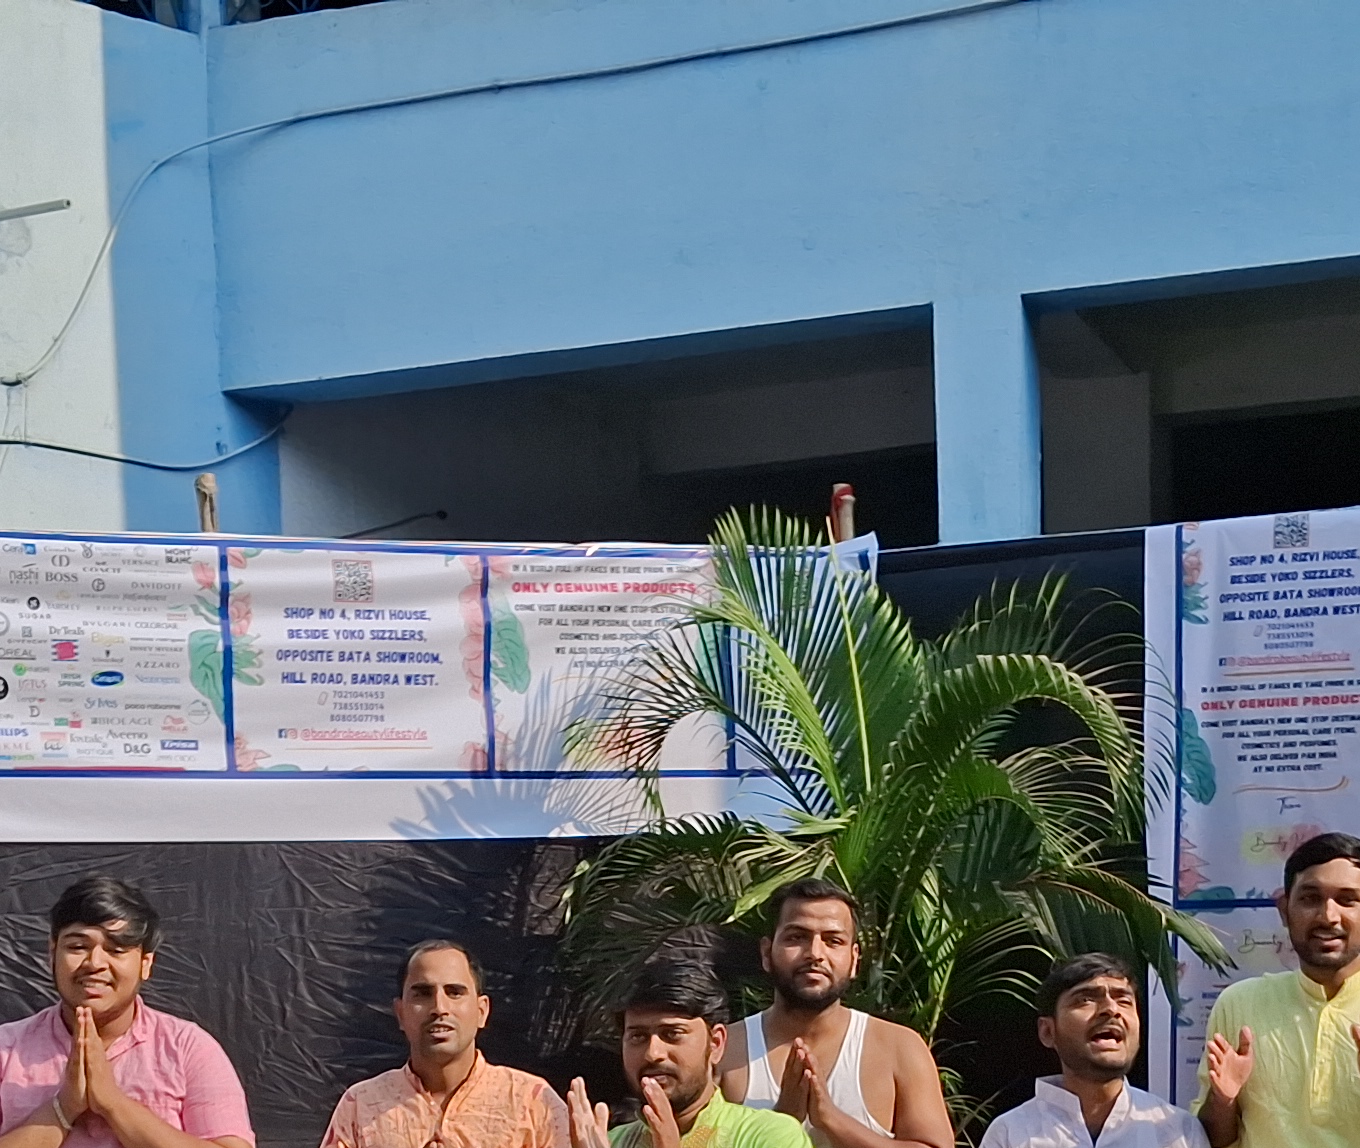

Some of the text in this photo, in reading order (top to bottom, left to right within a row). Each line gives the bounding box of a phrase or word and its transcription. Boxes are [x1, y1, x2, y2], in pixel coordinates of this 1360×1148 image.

[1228, 554, 1257, 567] SHOP
[1259, 553, 1275, 565] NO
[1290, 550, 1321, 563] RIZVI
[45, 571, 79, 583] BOSS
[1230, 572, 1268, 585] BESIDE
[1271, 570, 1299, 582] YOKO
[131, 581, 182, 590] DAVIDOFF
[512, 581, 549, 593] ONLY
[554, 582, 619, 593] GENUINE
[1218, 590, 1271, 604] OPPOSITE
[1273, 588, 1304, 601] BATA
[283, 607, 432, 621] SHOP NO 4, RIZVI HOUSE,
[1222, 609, 1245, 622] HILL
[1283, 606, 1330, 619] BANDRA
[287, 628, 428, 642] BESIDE YOKO SIZZLERS,
[276, 649, 444, 664] OPPOSITE BATA SHOWROOM,
[135, 662, 181, 670] AZZARO
[281, 671, 439, 686] HILL ROAD, BANDRA WEST.
[1201, 699, 1236, 711] ONLY
[1238, 697, 1299, 709] GENUINE
[301, 728, 428, 741] @bandrabeautylifestyle
[124, 743, 151, 754] D&G
